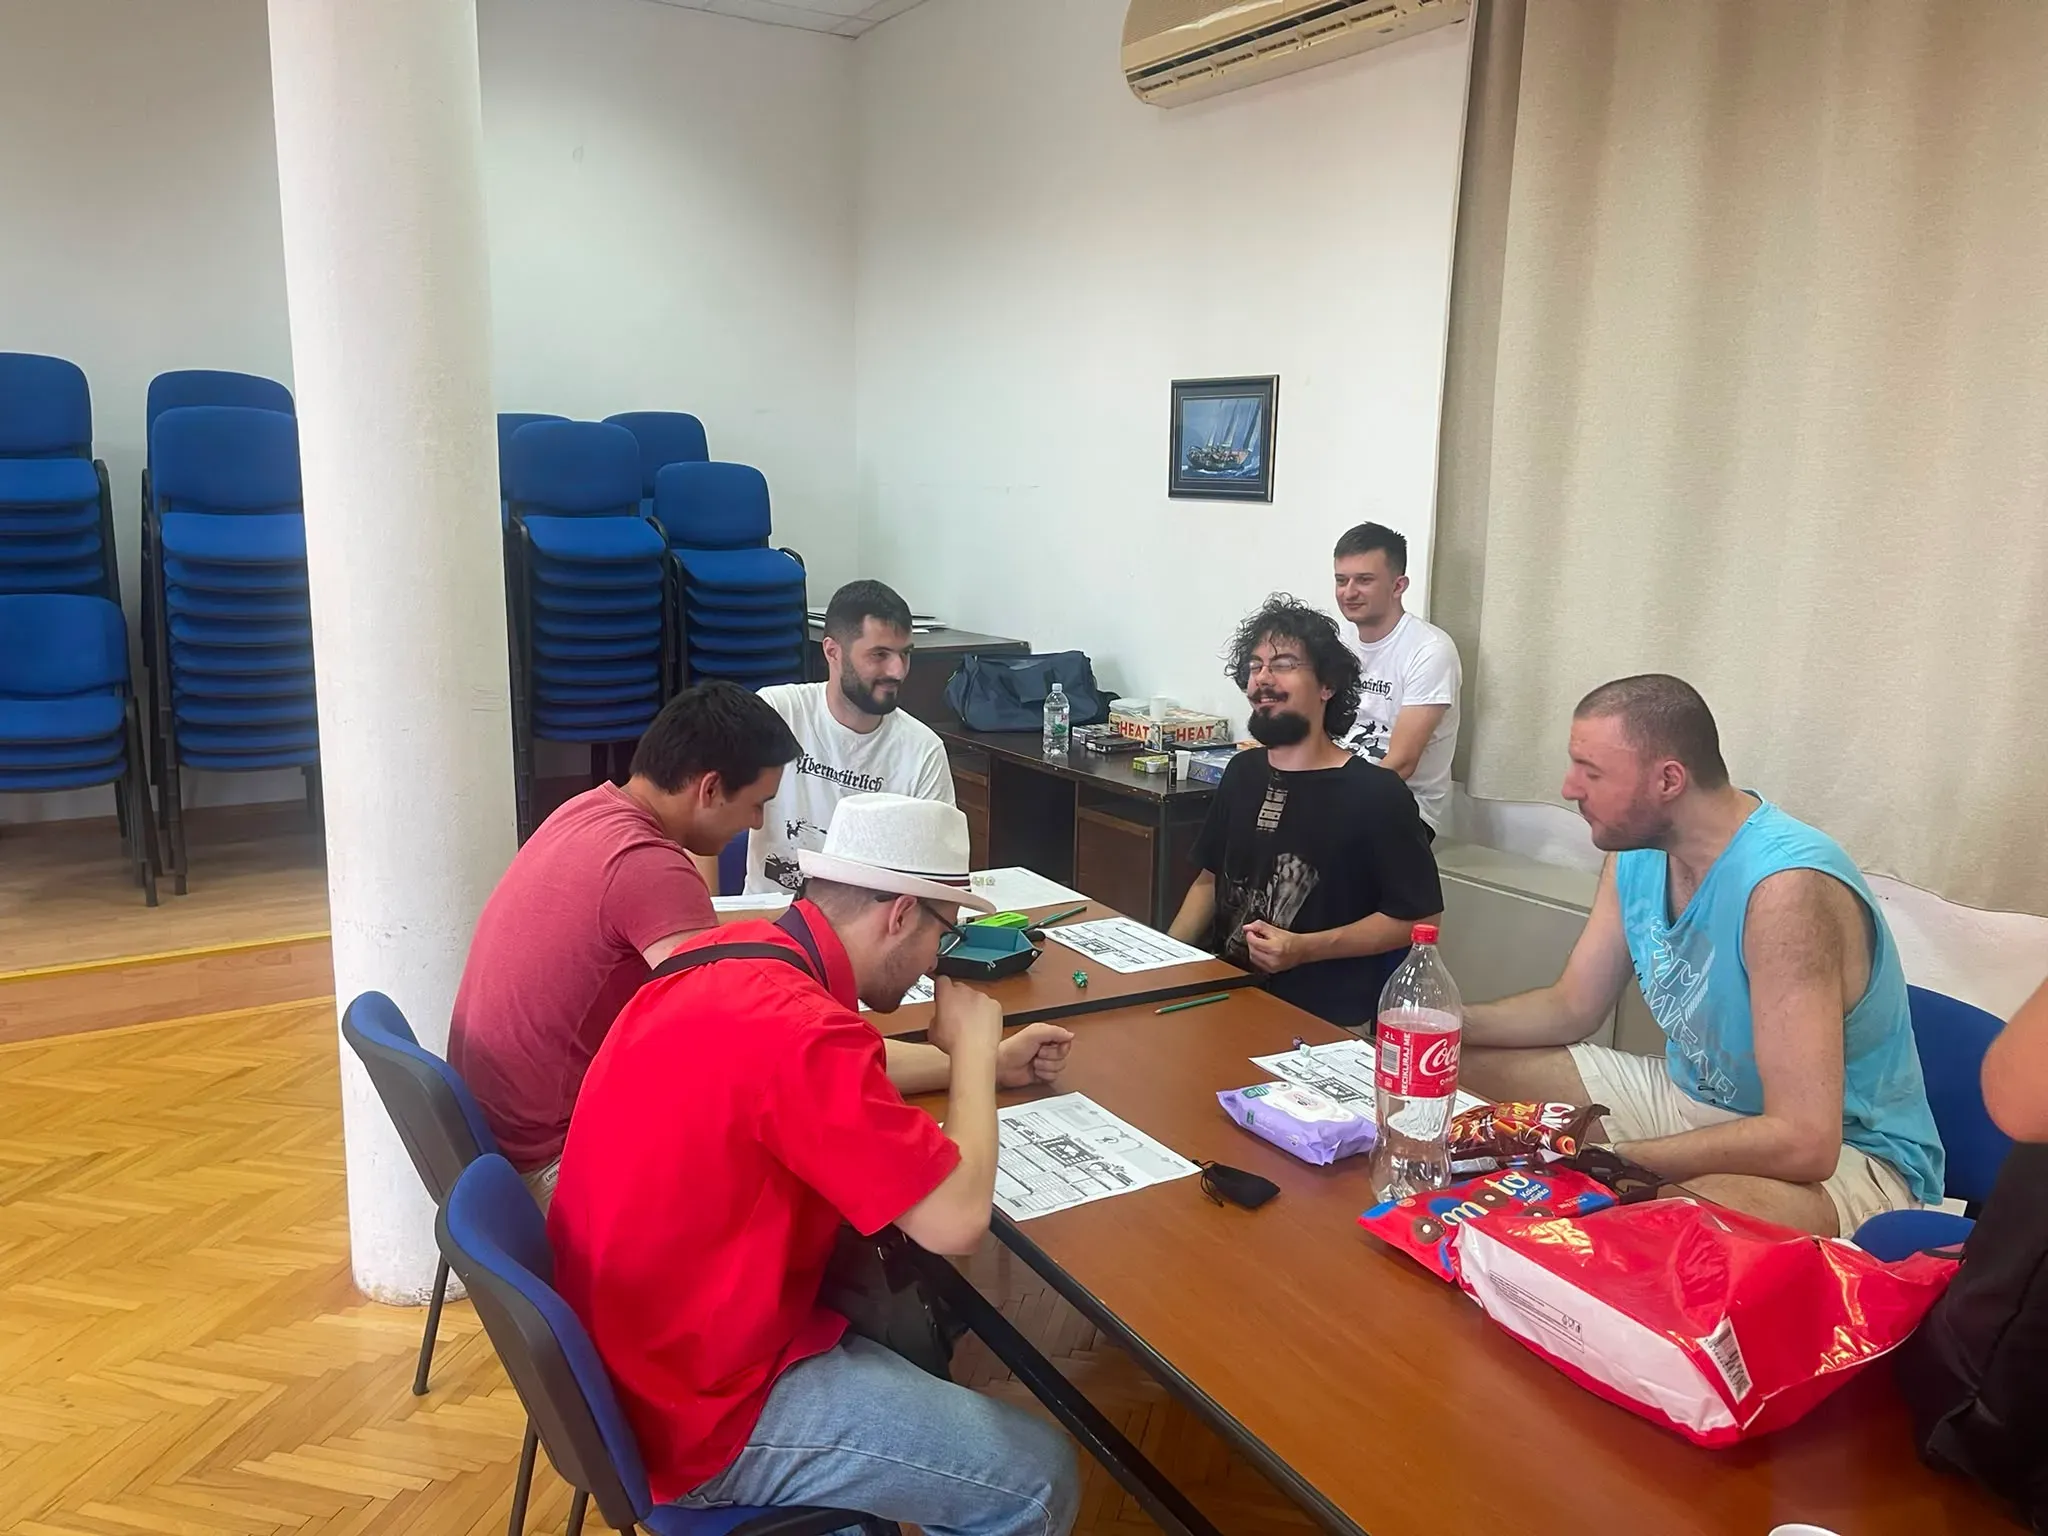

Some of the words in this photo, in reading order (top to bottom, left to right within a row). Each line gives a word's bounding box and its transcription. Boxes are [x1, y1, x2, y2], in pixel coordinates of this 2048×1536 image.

[1120, 721, 1150, 741] HEAT
[1177, 725, 1215, 741] HEAT
[1403, 1032, 1411, 1046] ME
[1401, 1046, 1411, 1095] RECIKLIRAJ
